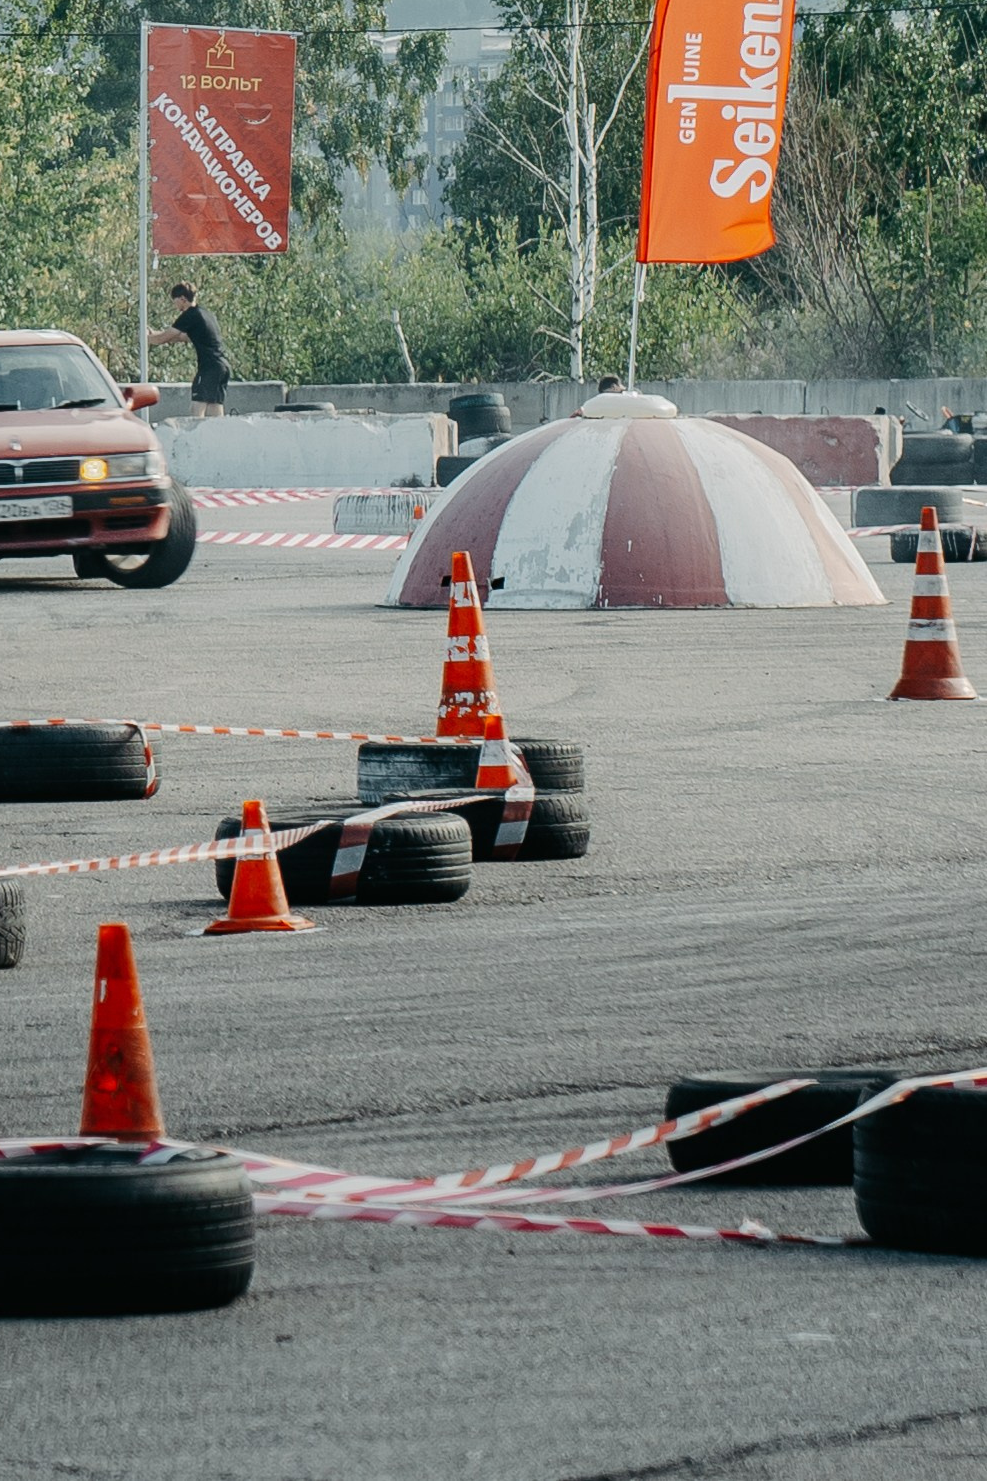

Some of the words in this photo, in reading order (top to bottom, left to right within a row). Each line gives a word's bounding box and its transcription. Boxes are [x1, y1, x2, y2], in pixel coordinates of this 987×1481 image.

[180, 75, 196, 89] 12
[201, 76, 262, 91] ВОЛЬТ
[680, 32, 702, 144] GENUINE
[150, 92, 283, 251] КОНДИЦИОНЕРОВ
[195, 105, 271, 201] ЗАПРАВКА
